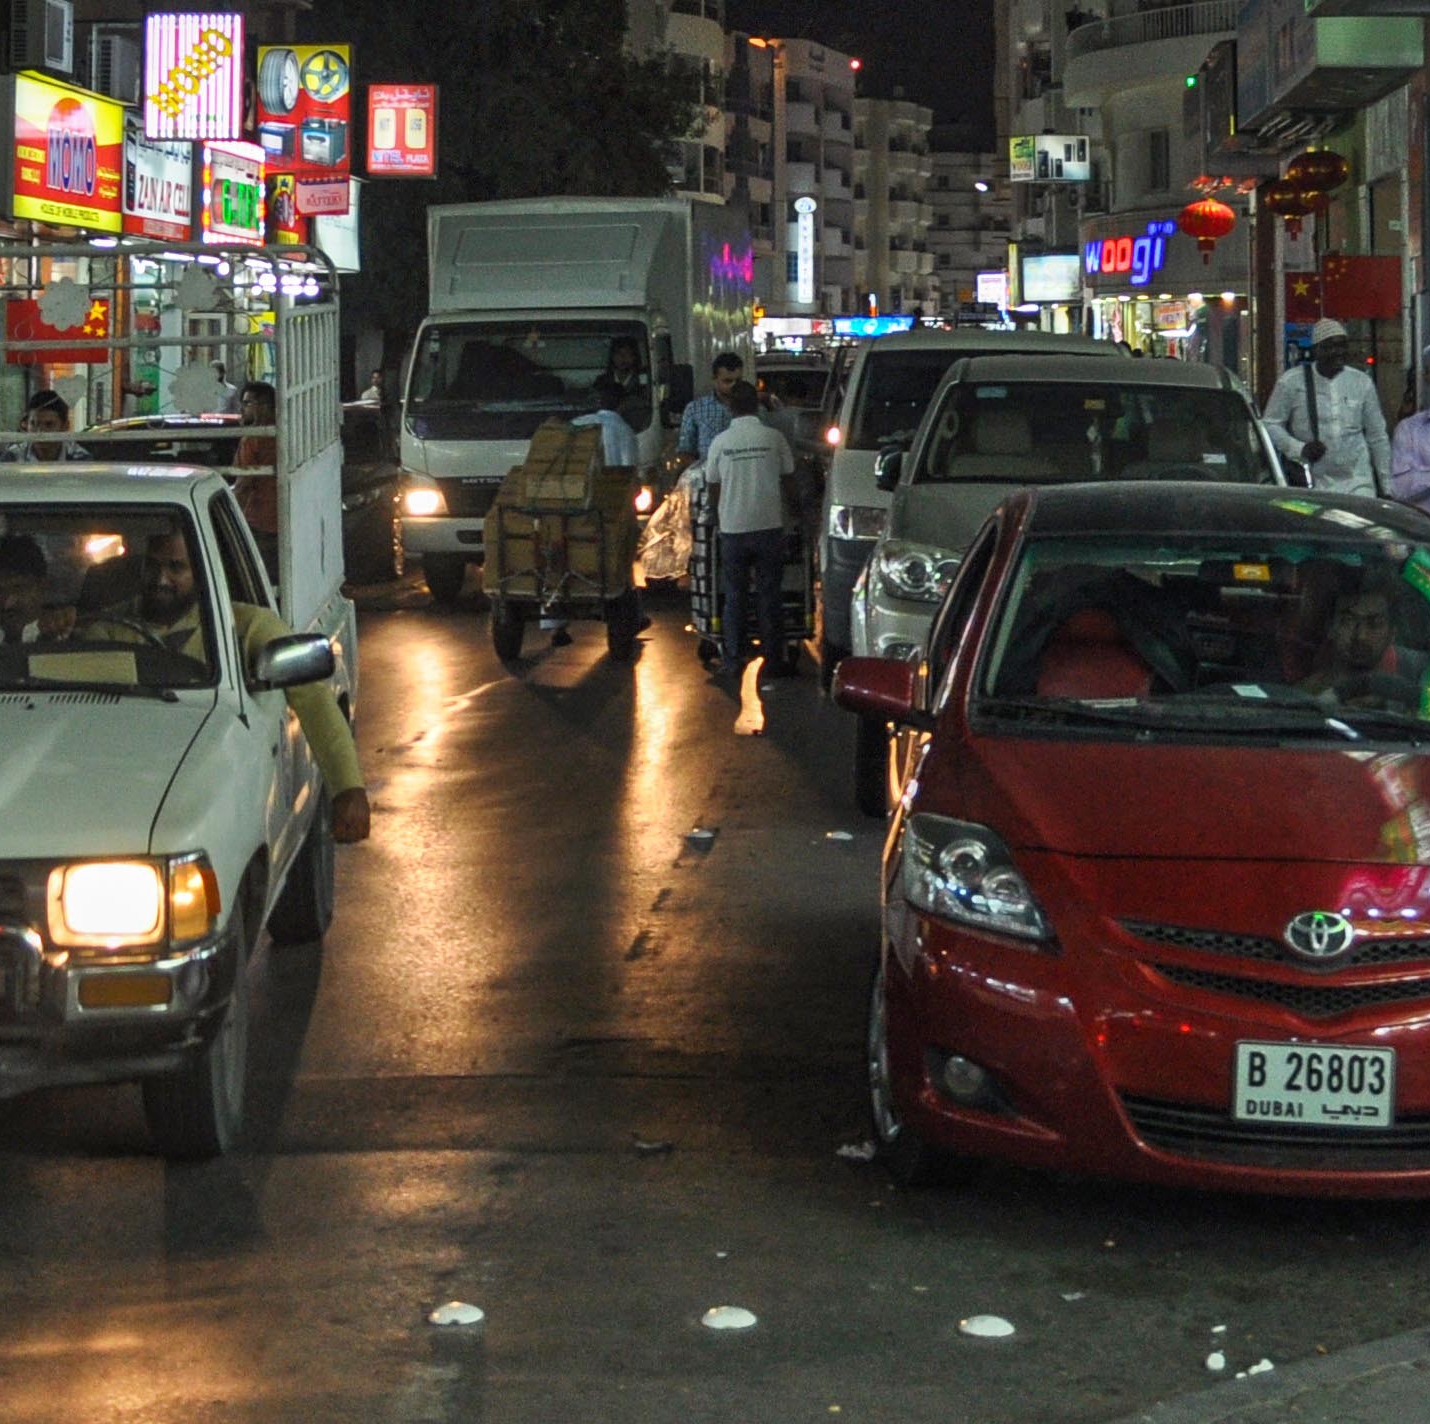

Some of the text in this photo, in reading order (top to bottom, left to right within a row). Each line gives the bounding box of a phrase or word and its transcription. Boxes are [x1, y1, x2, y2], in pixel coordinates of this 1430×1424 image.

[46, 126, 97, 198] MOMO
[1246, 1050, 1387, 1097] B 26803
[1245, 1098, 1304, 1119] DUBAI
